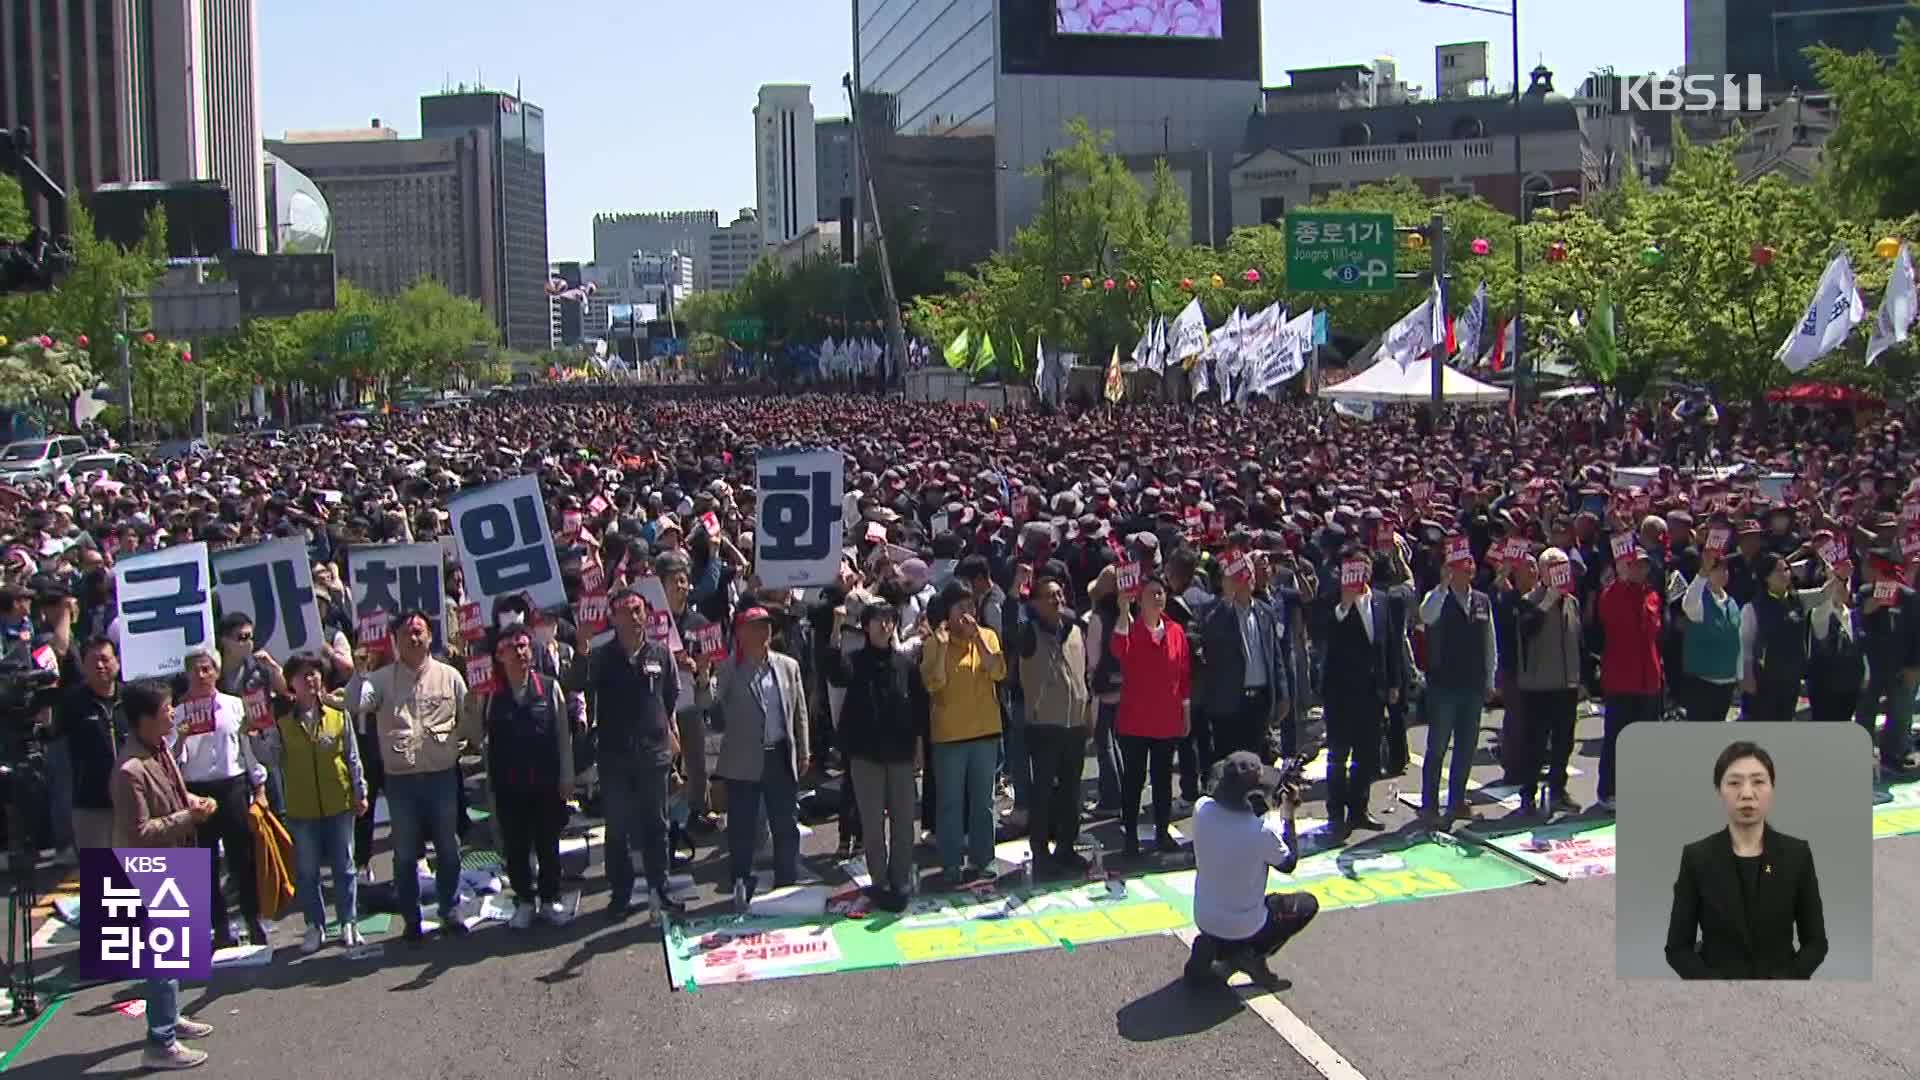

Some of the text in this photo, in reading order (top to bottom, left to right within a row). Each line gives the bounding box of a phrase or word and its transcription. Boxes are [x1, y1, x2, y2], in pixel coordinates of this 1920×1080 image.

[1295, 221, 1384, 245] 종로1가
[1344, 267, 1353, 280] 6
[760, 466, 842, 561] 화
[460, 496, 553, 597] 임
[1341, 570, 1365, 584] OUT
[122, 560, 207, 646] 국
[219, 560, 313, 652] 가
[355, 560, 443, 654] 책
[579, 606, 606, 622] OUT
[361, 624, 386, 643] OUT
[468, 668, 493, 688] OUT
